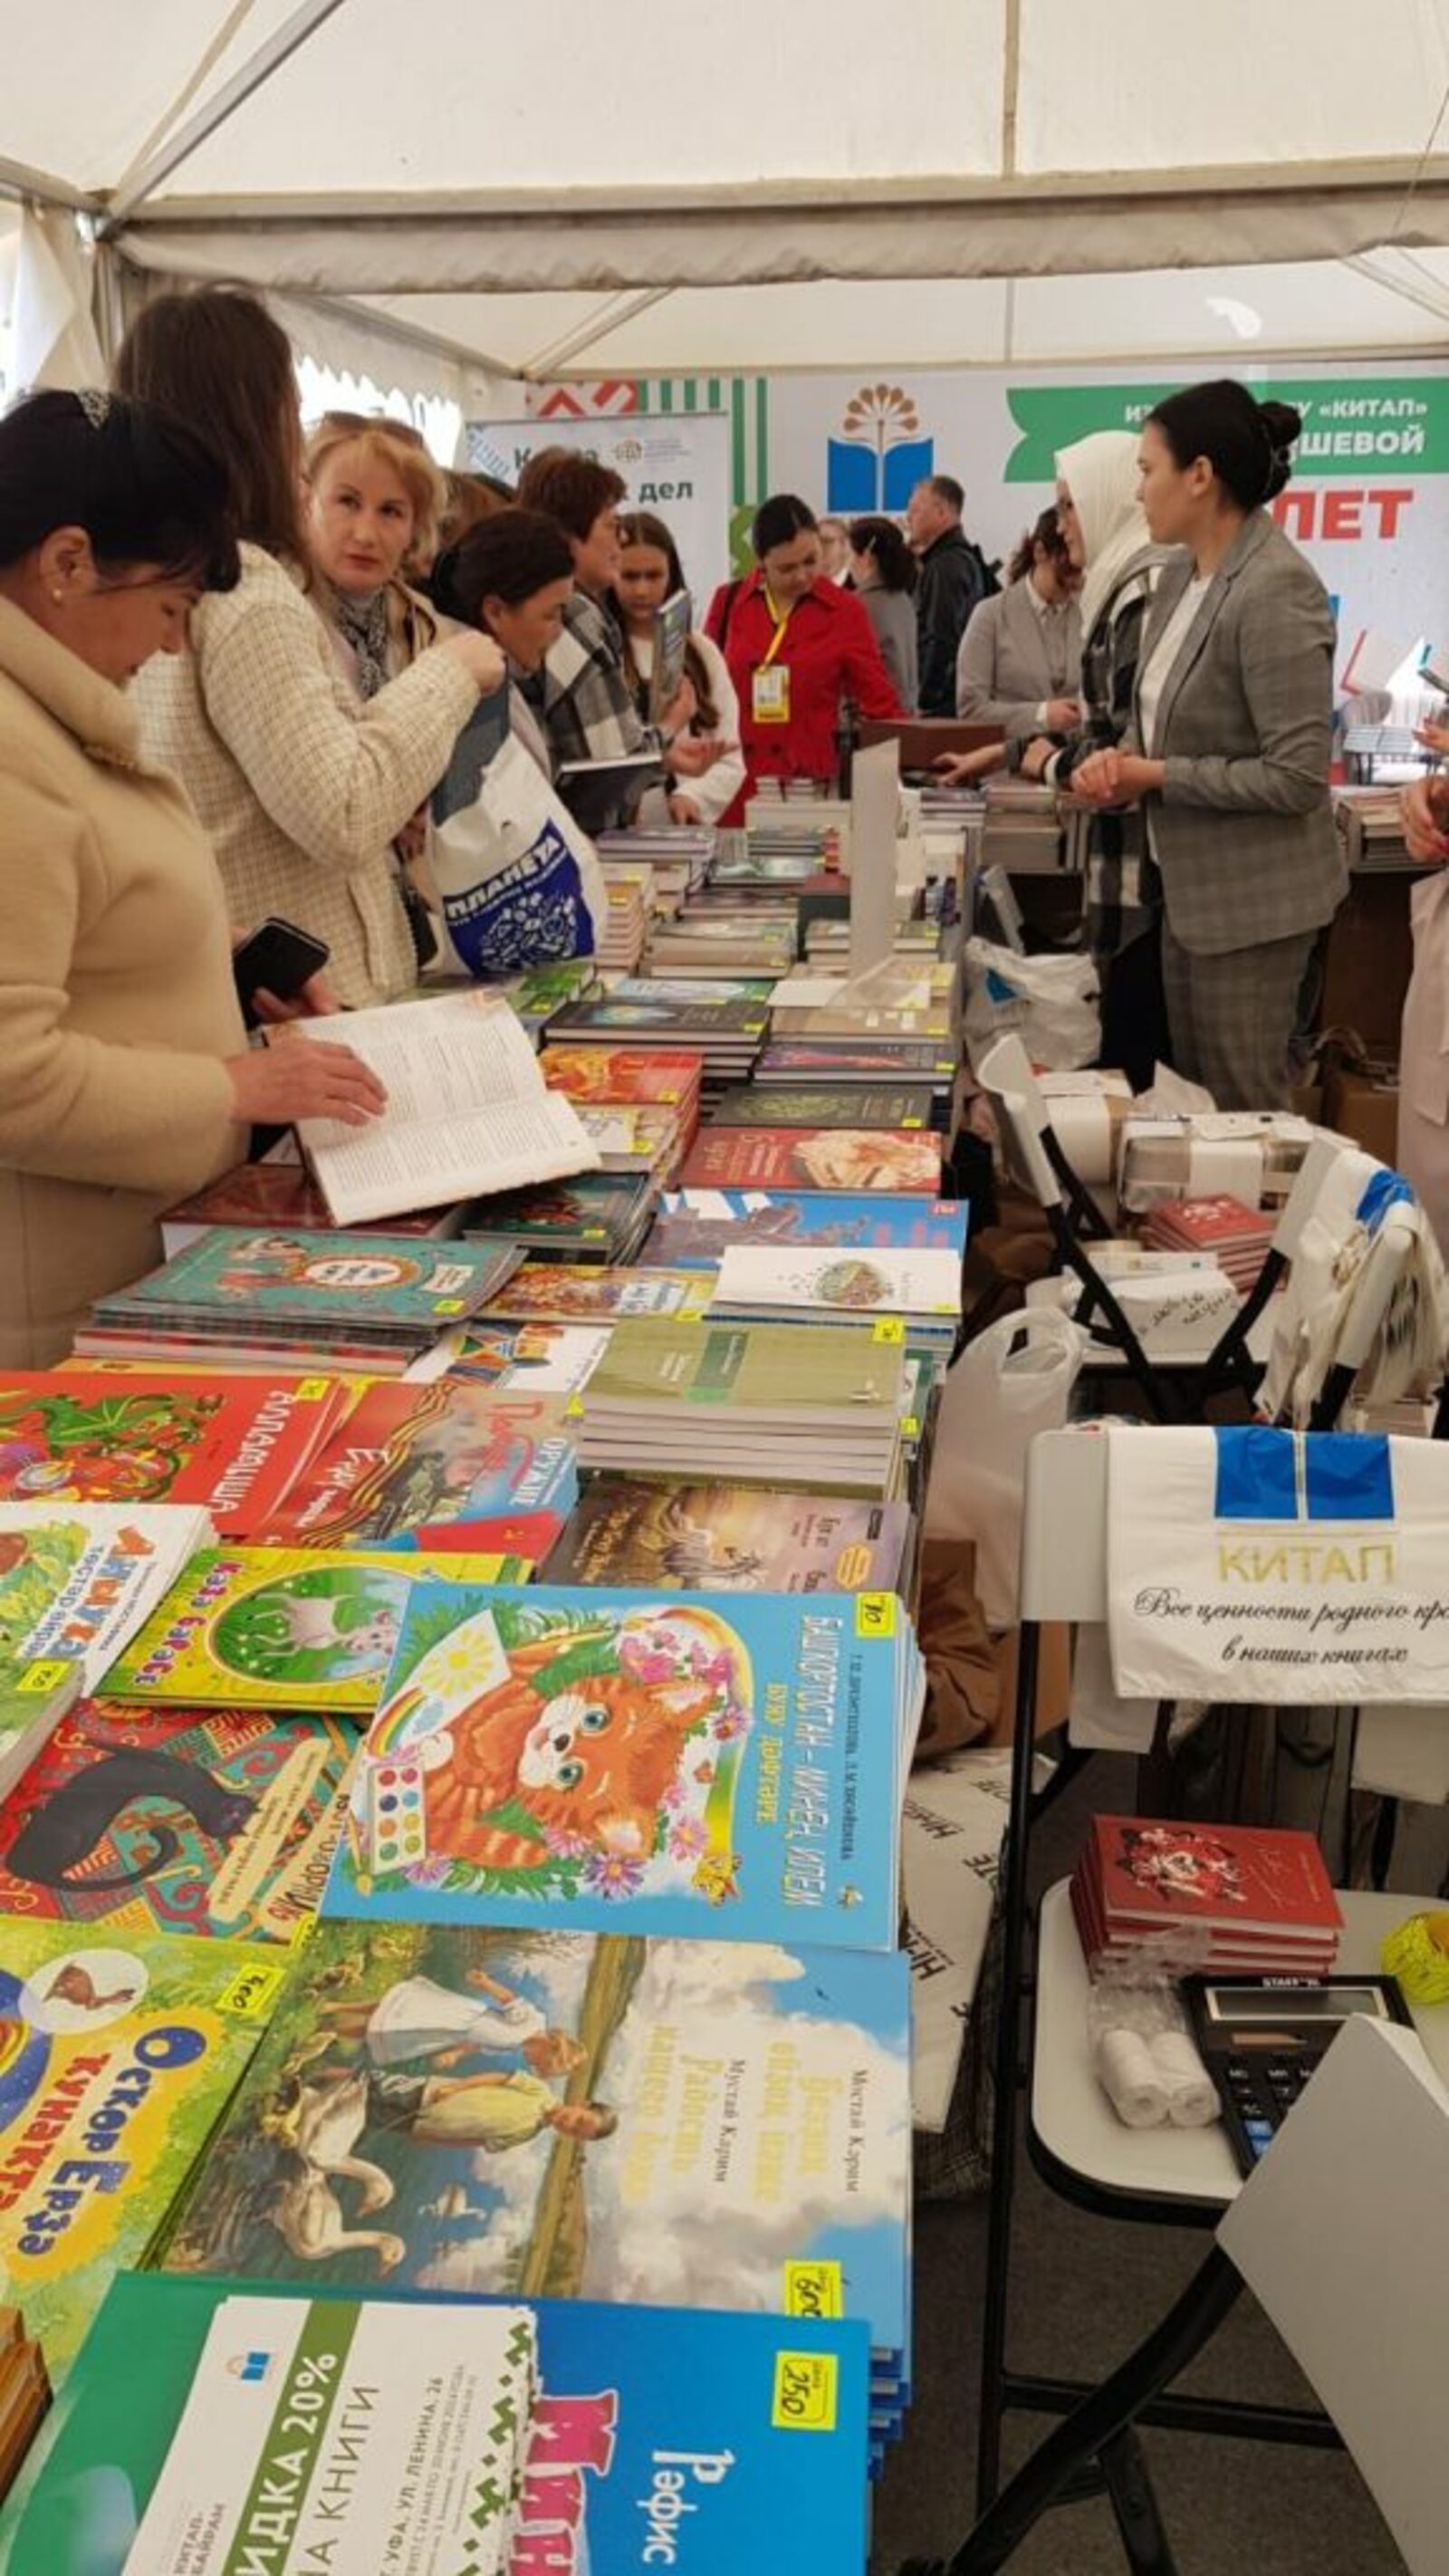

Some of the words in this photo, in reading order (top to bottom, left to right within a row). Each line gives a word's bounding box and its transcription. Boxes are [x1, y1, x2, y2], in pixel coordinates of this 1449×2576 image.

[1319, 399, 1427, 418] «КИТАП»
[638, 481, 694, 504] дел
[1272, 489, 1414, 541] ЛЕТ
[446, 834, 562, 919] ПЛАНЕТА
[208, 1390, 294, 1514] АЛПАМЫША
[1218, 1543, 1396, 1585] КИТАП
[1133, 1587, 1196, 1618] Все
[1196, 1601, 1311, 1626] ценности
[1310, 1600, 1408, 1631] родного
[1243, 1647, 1316, 1664] наших
[1320, 1646, 1409, 1666] книгах
[672, 2052, 724, 2173] Радость
[724, 2059, 747, 2120] Мустай
[713, 2125, 738, 2183] Карим
[282, 2353, 338, 2435] 20%
[782, 2363, 811, 2417] 250
[313, 2384, 380, 2523] КНИГИ
[405, 2398, 439, 2477] ЛЕНИНА,
[425, 2376, 444, 2394] 26
[637, 2447, 736, 2565] Рәфис
